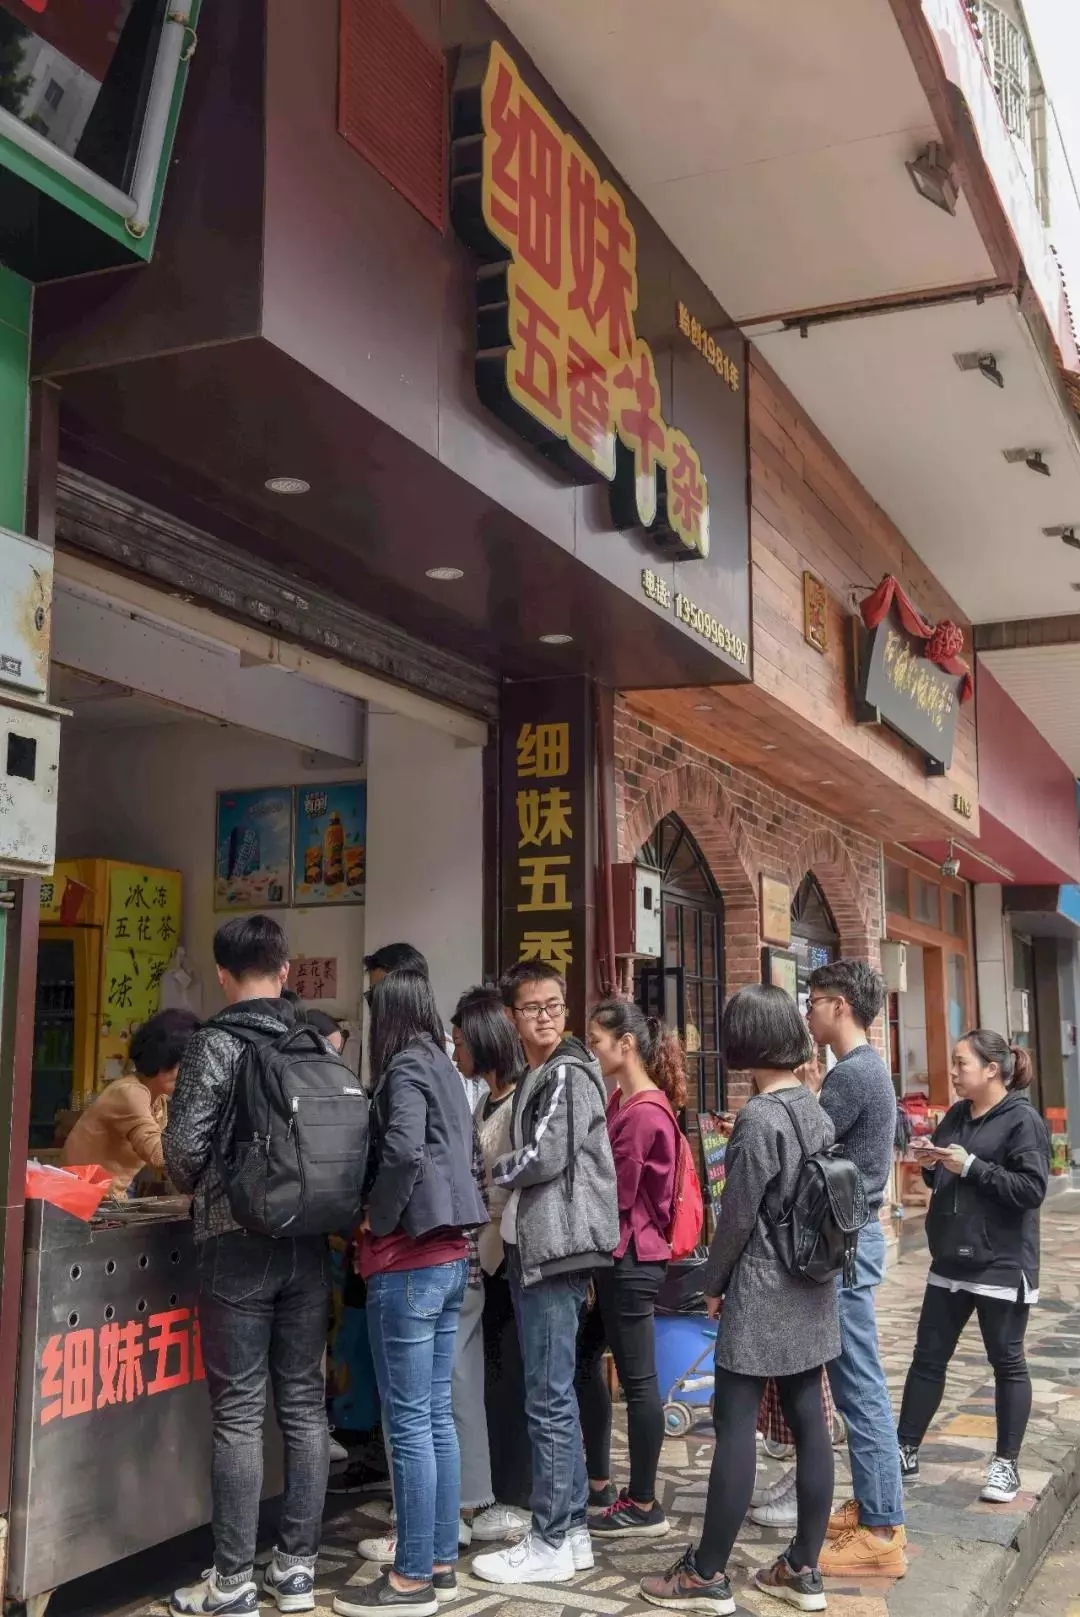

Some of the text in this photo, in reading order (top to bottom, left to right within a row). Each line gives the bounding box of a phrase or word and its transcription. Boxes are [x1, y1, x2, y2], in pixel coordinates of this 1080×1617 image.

[490, 62, 633, 360] 细妹
[515, 282, 704, 534] 五香牛杂
[115, 916, 176, 942] 五花茶
[125, 884, 168, 910] 冰冻
[40, 1305, 207, 1426] 细妹五
